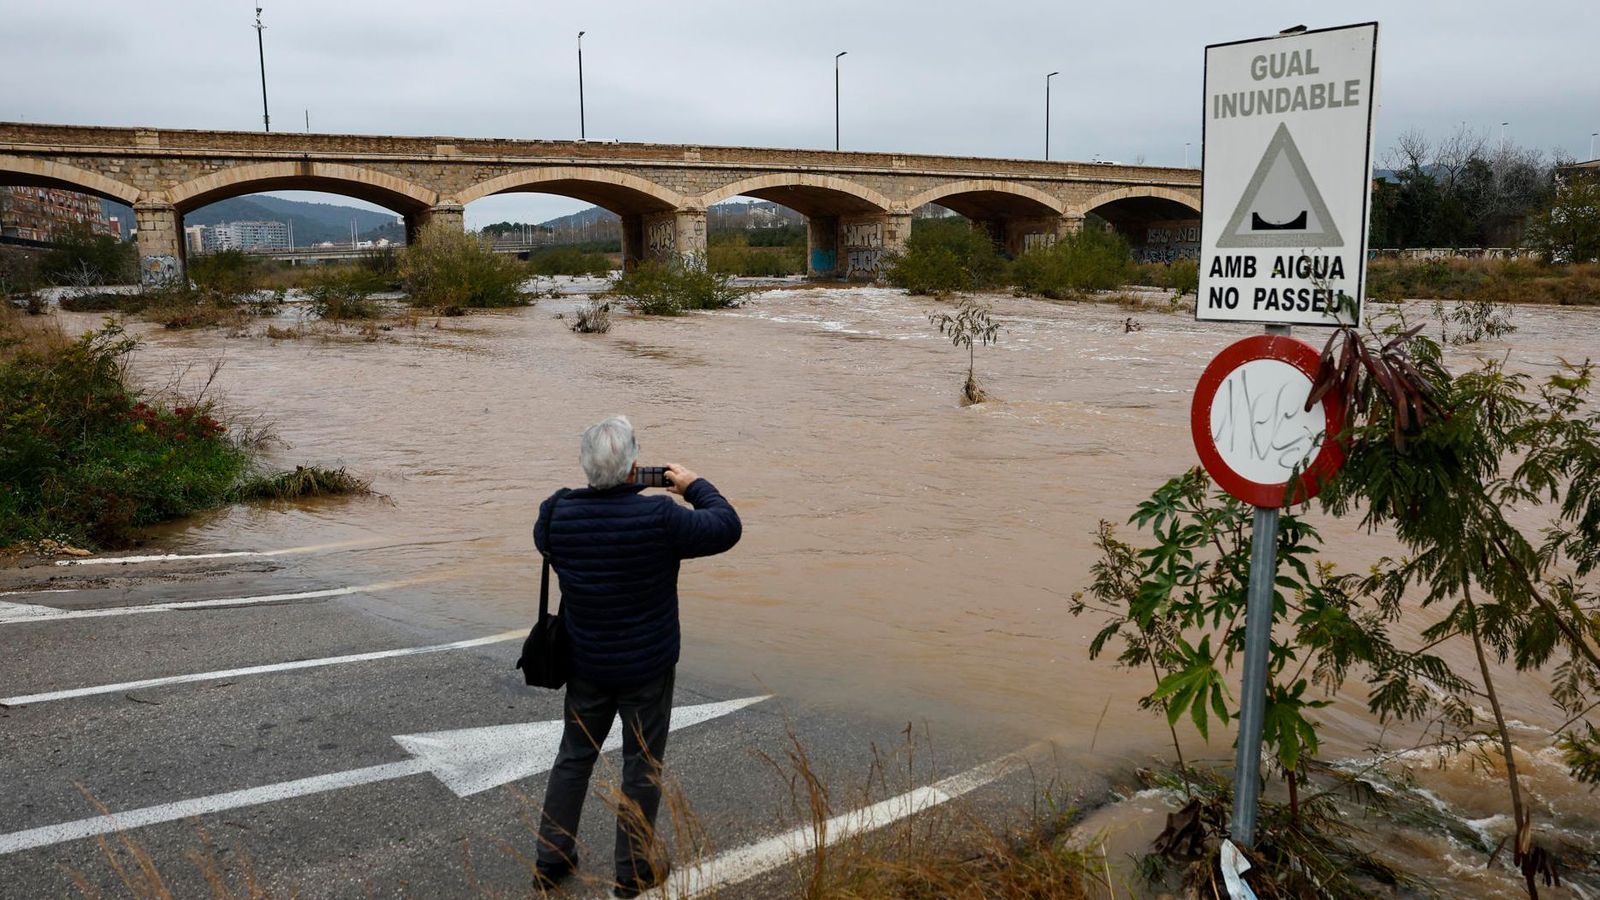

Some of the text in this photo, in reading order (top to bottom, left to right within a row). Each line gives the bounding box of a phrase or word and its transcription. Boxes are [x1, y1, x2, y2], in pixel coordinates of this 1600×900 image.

[1251, 49, 1320, 81] GUAL
[1213, 79, 1360, 119] INUNDABLE
[1209, 255, 1345, 280] AMB AIGUA
[1208, 286, 1344, 313] NO PASSEU
